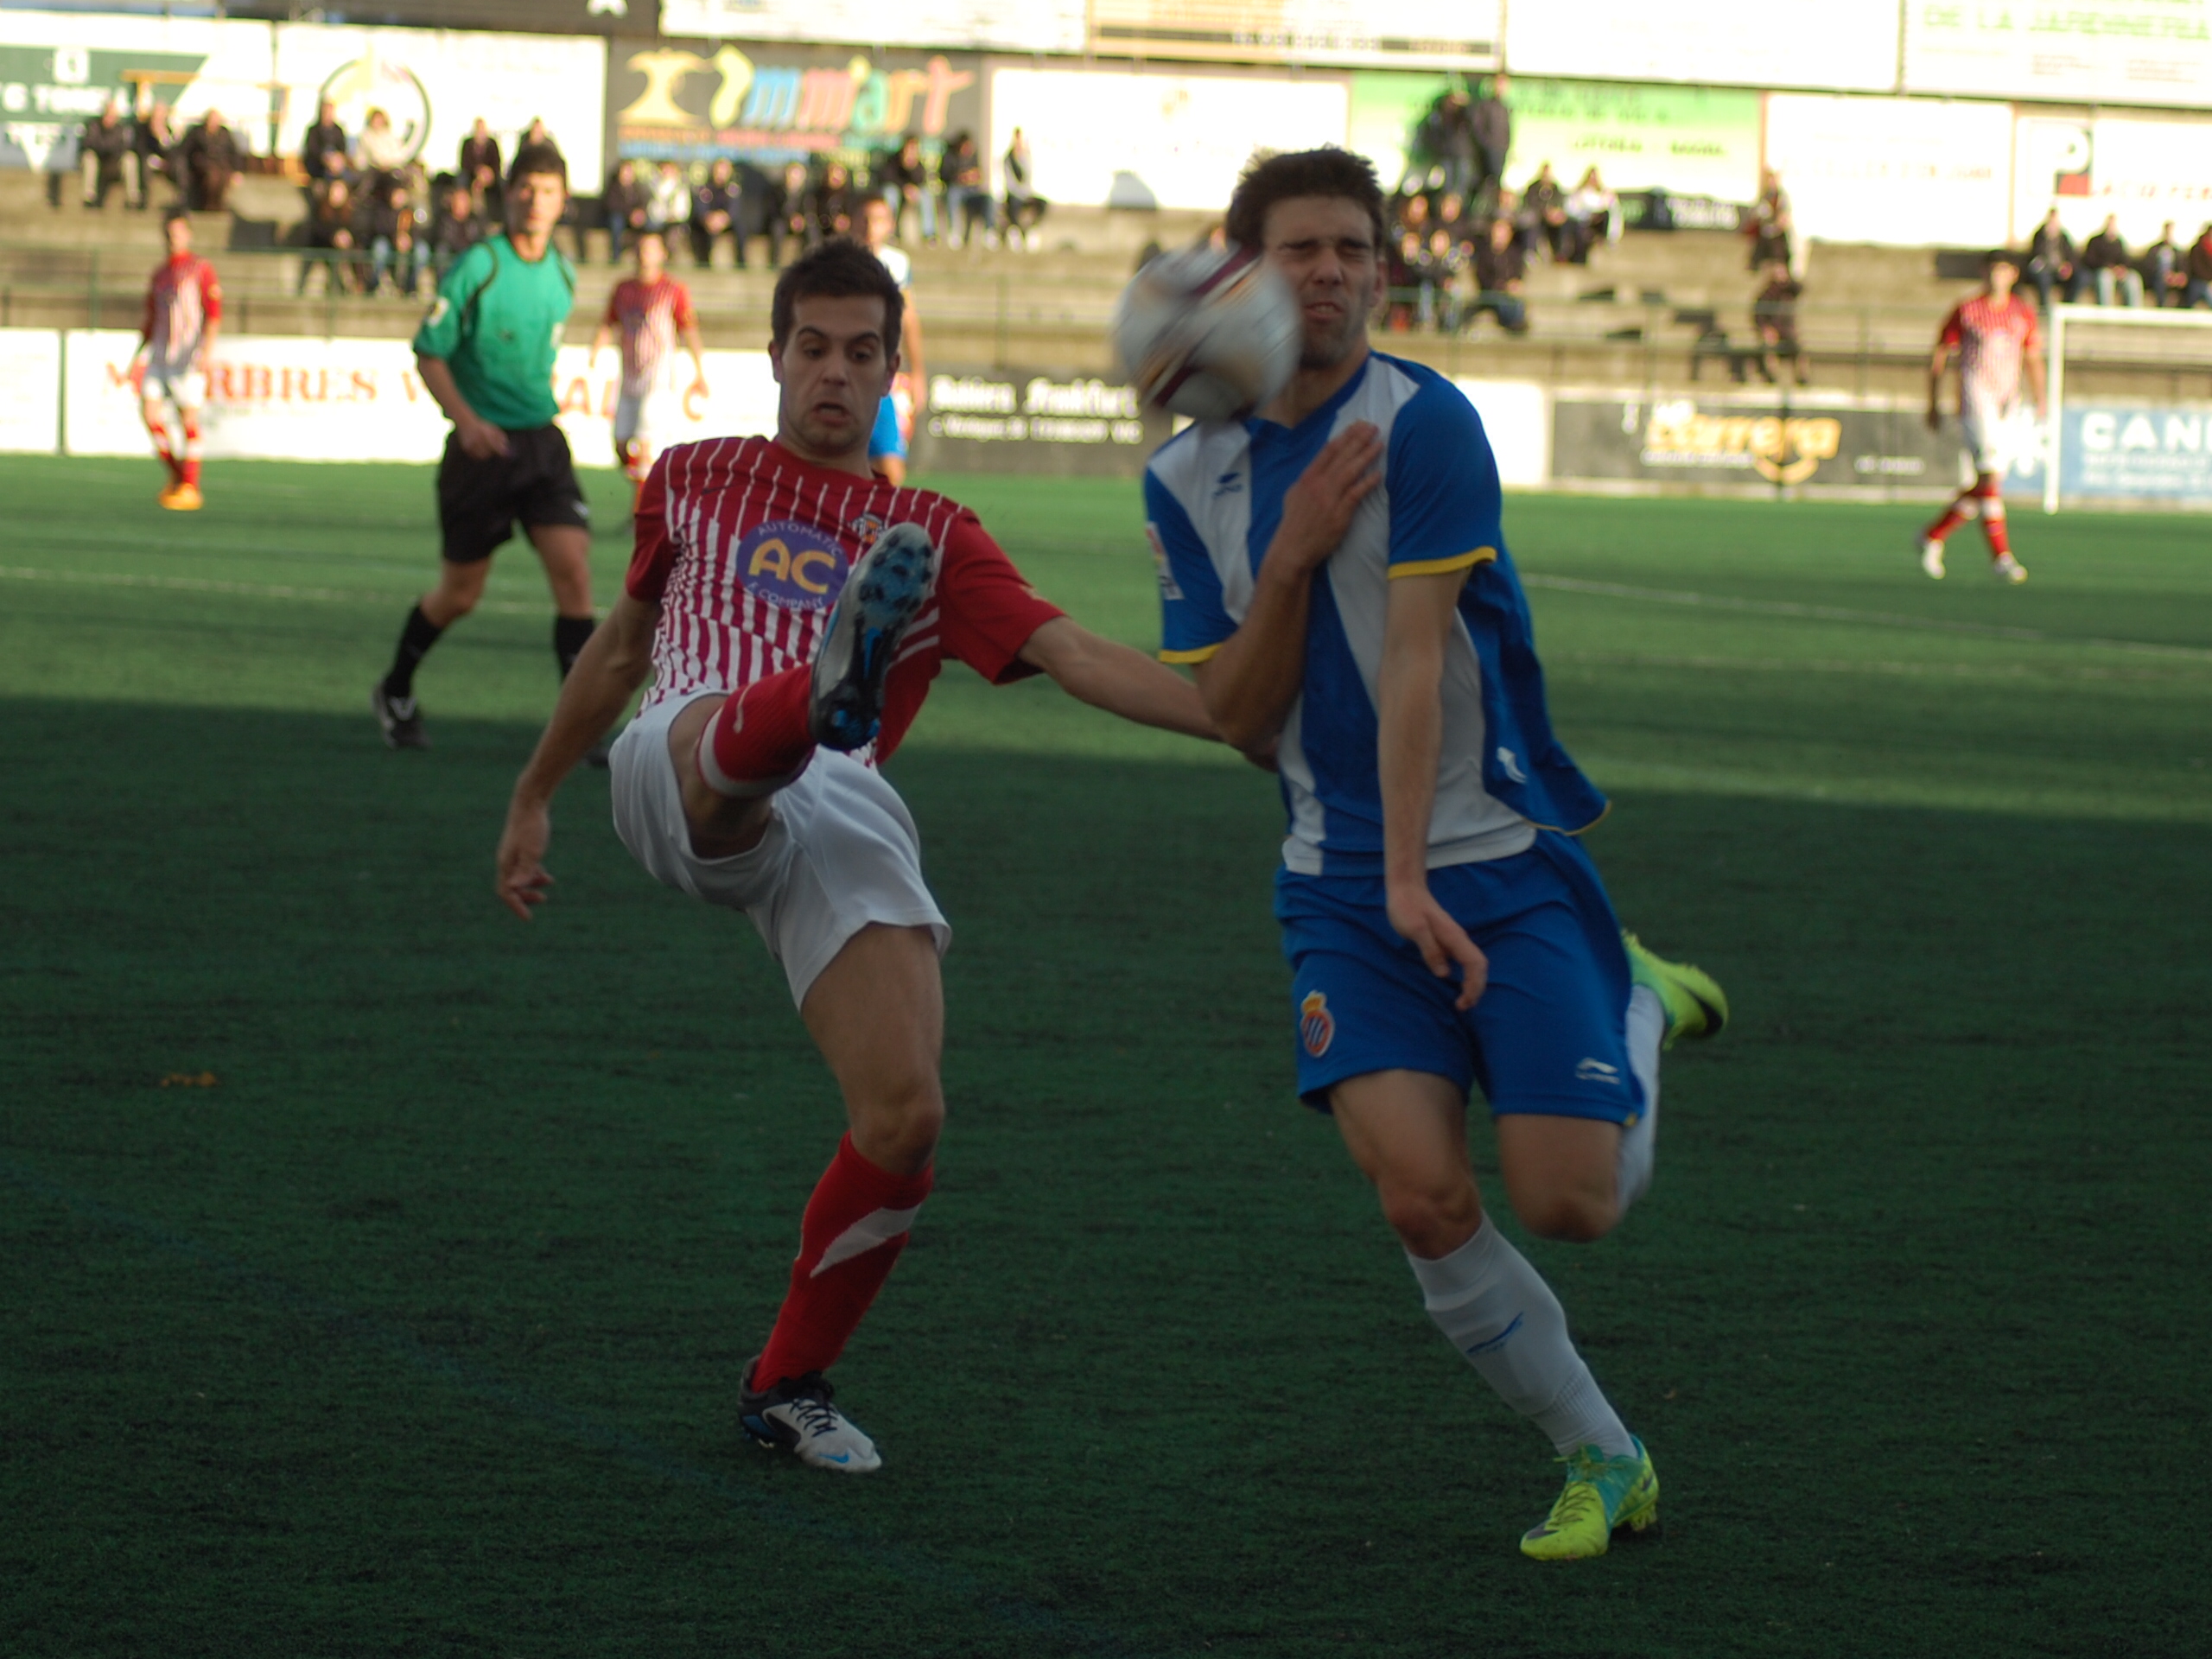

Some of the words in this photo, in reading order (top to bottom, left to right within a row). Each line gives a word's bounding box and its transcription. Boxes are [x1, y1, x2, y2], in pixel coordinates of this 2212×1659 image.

[758, 521, 843, 556] AUTOMATIC
[747, 537, 837, 595] AC
[759, 588, 824, 610] COMPANY
